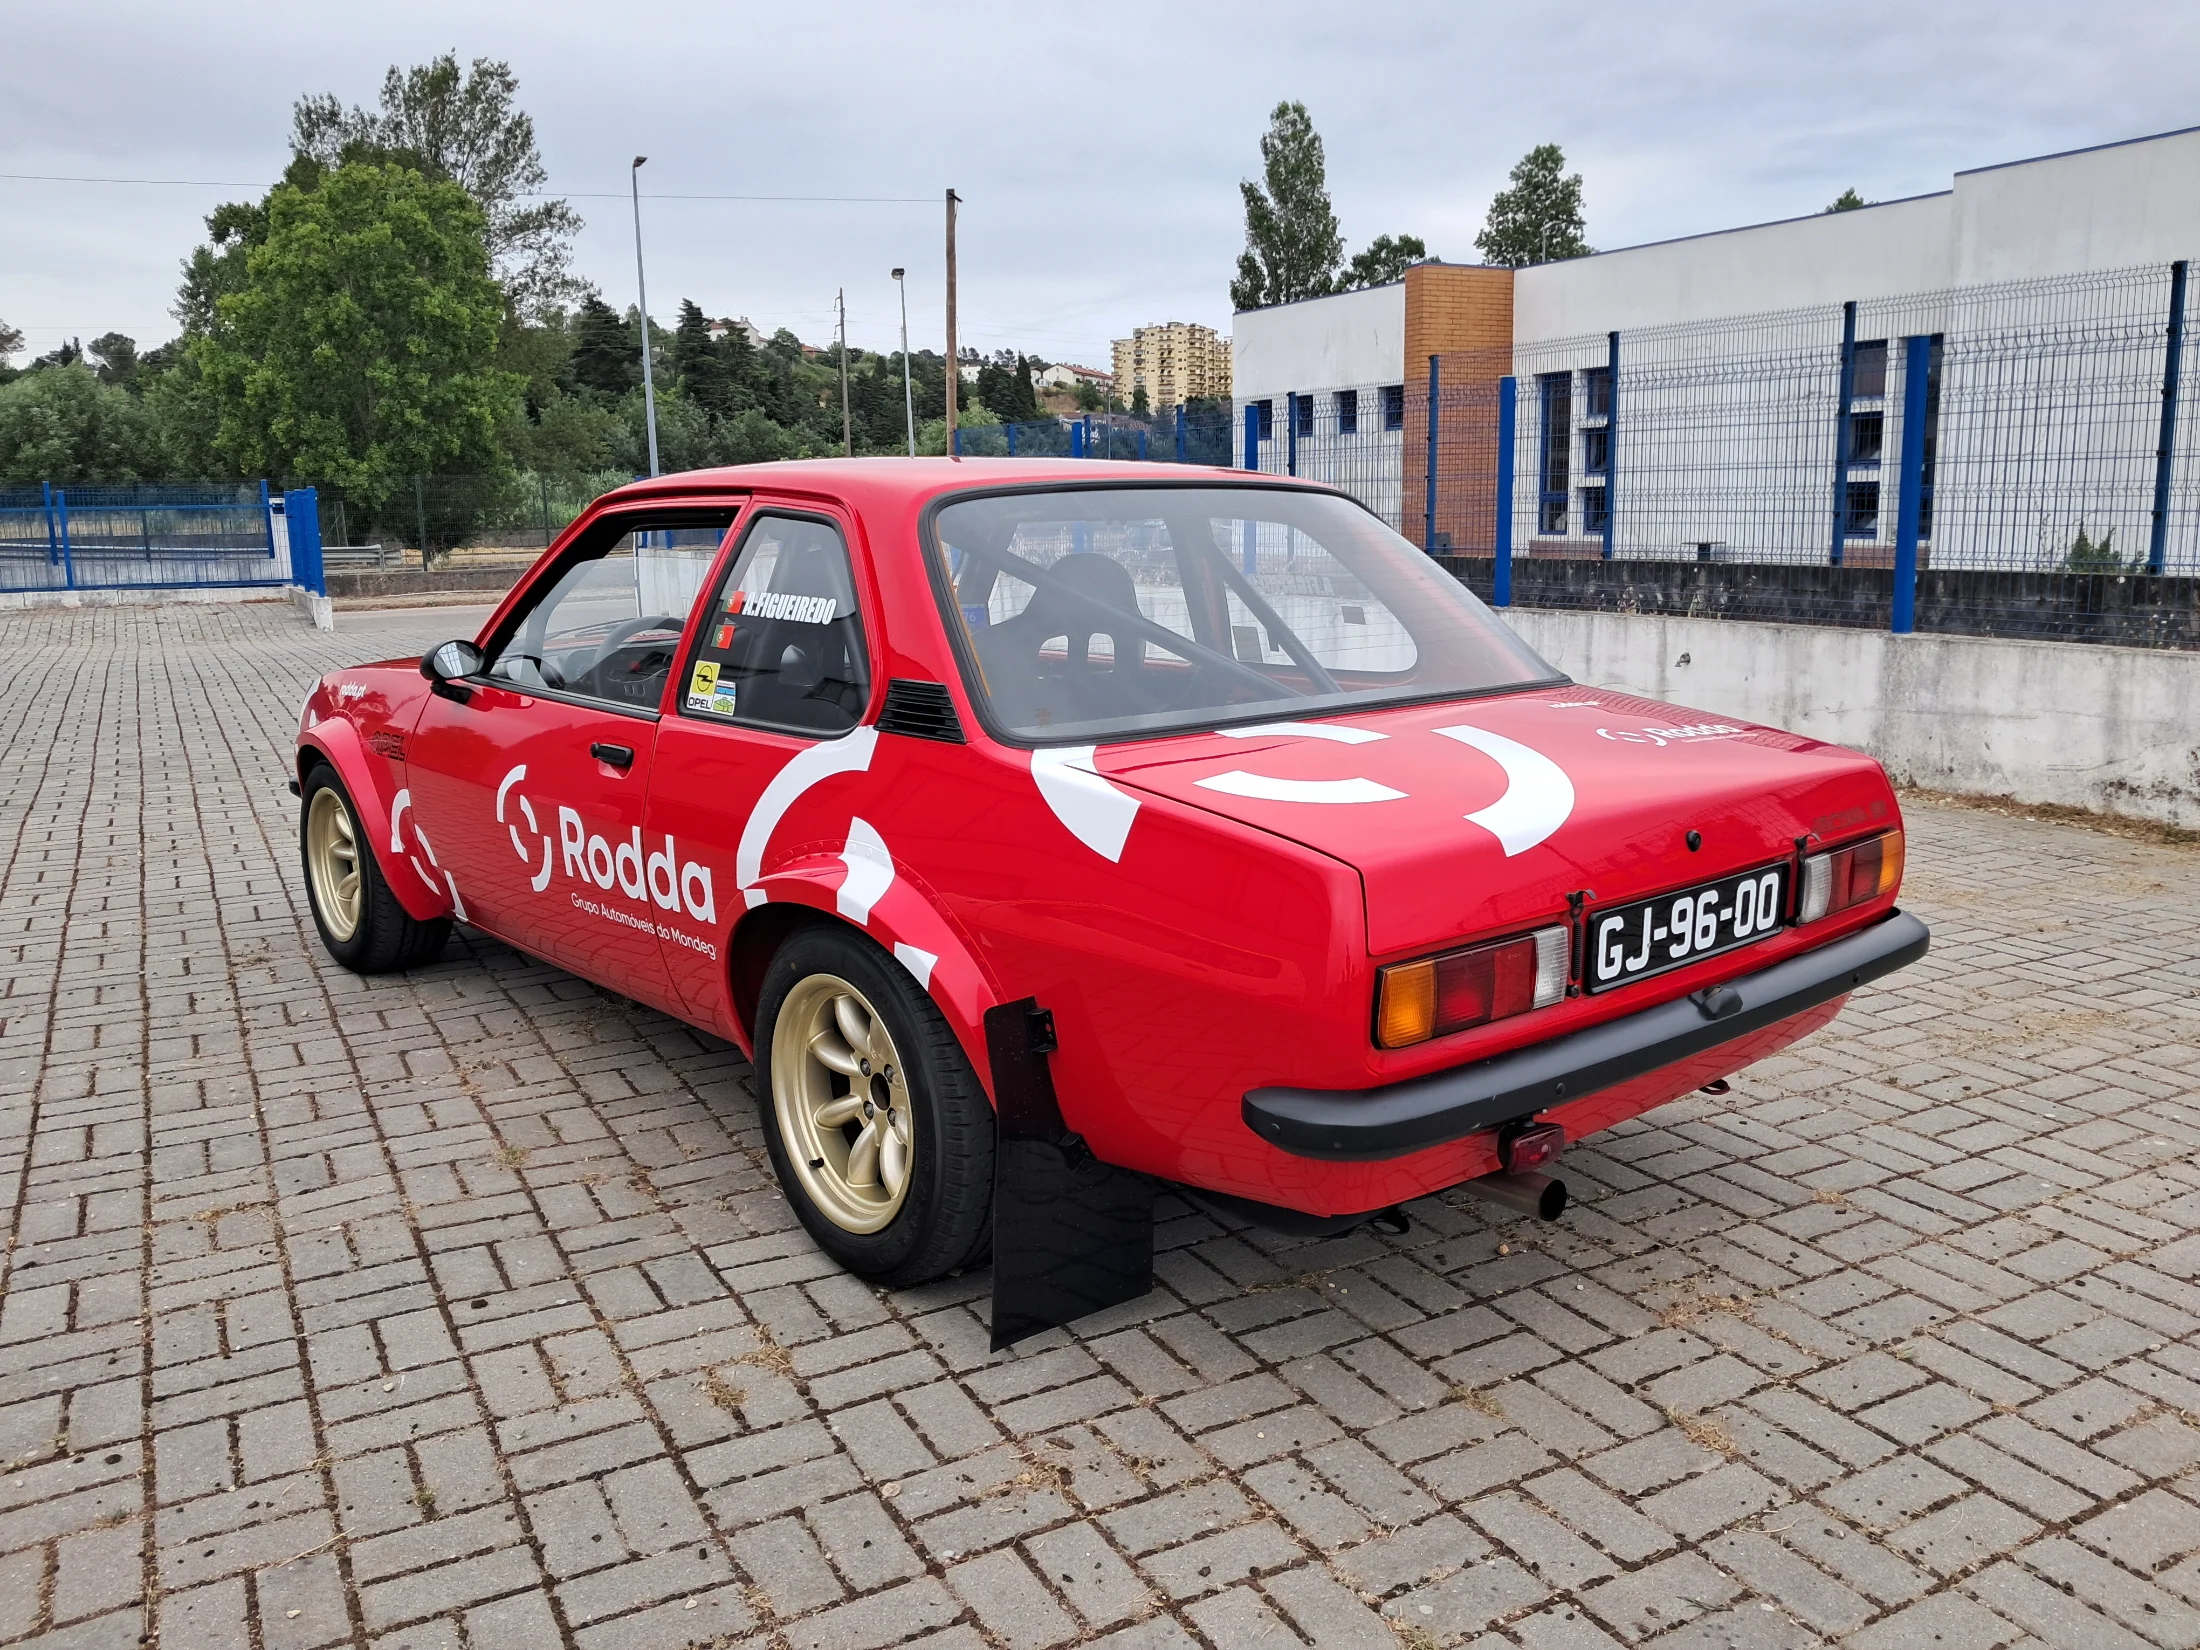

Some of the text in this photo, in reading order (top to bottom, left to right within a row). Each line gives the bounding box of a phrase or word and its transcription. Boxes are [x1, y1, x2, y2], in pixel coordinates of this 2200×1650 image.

[742, 592, 837, 625] A.FIGUEIREDO
[688, 697, 712, 709] OPEL
[558, 805, 716, 924] Rodda
[571, 892, 716, 960] Grupo Automóveis do Mondeg
[1597, 872, 1779, 980] GJ-96-00
